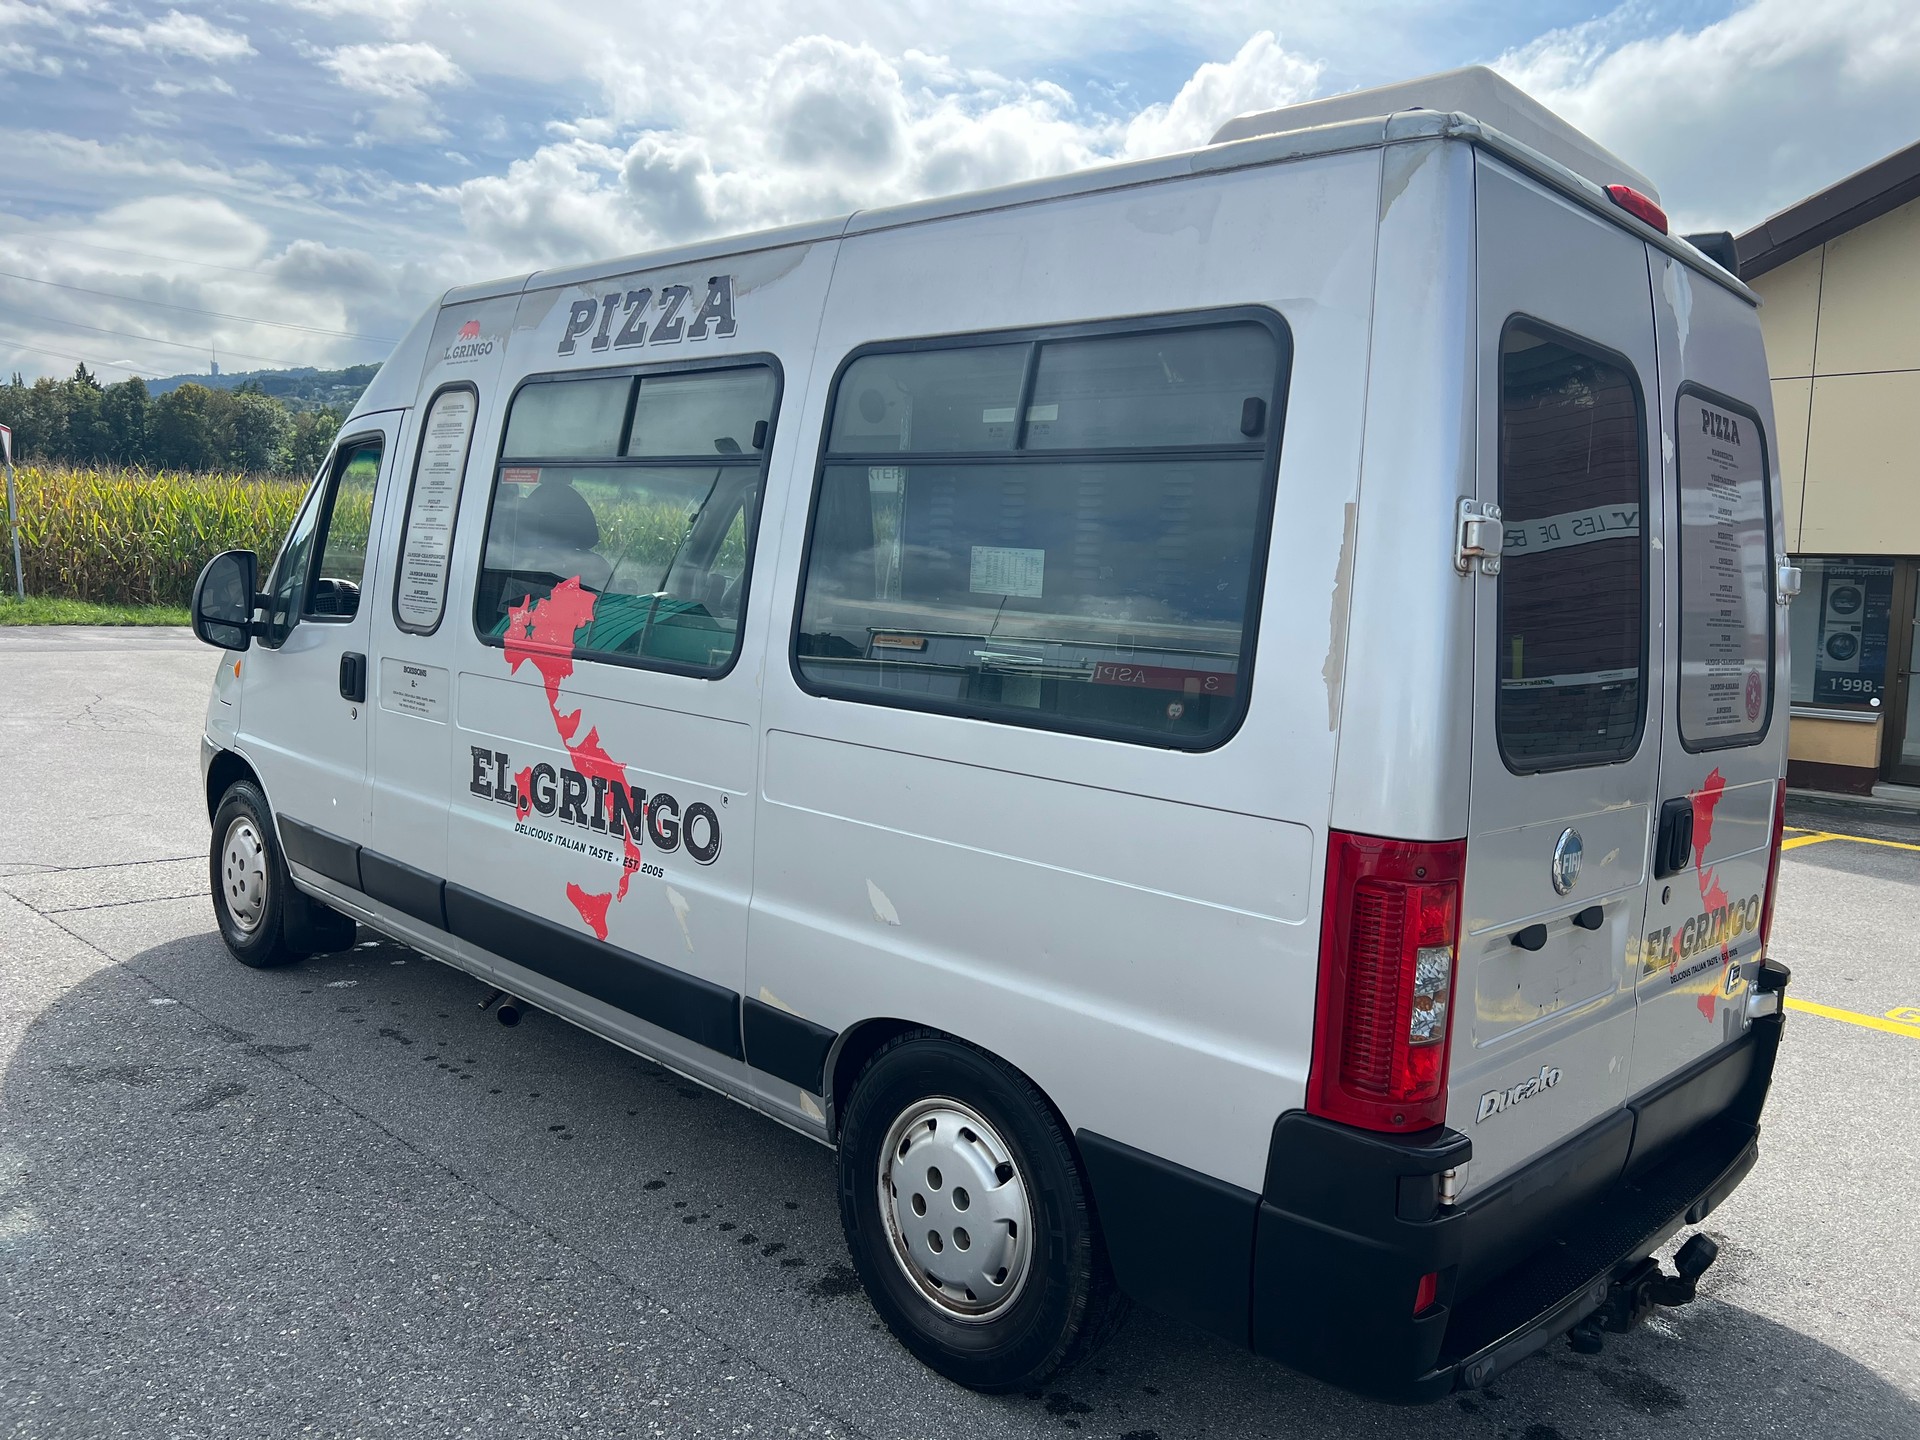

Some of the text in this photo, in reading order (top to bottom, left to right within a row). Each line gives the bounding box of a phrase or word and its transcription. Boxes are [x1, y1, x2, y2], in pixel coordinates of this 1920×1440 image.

[557, 275, 738, 357] PIZZA
[1701, 408, 1741, 446] PIZZA
[470, 746, 722, 866] EL.GRINGO
[514, 822, 664, 878] DELICIOUS ITALIAN TASTE EST. 2005
[1562, 850, 1582, 875] FIAT
[1643, 893, 1760, 977] EL.GRINGO
[1670, 969, 1691, 984] DELICIOUS
[1691, 961, 1707, 974] ITALIAN
[1707, 956, 1719, 968] TASTE
[1475, 1064, 1563, 1124] Ducato
